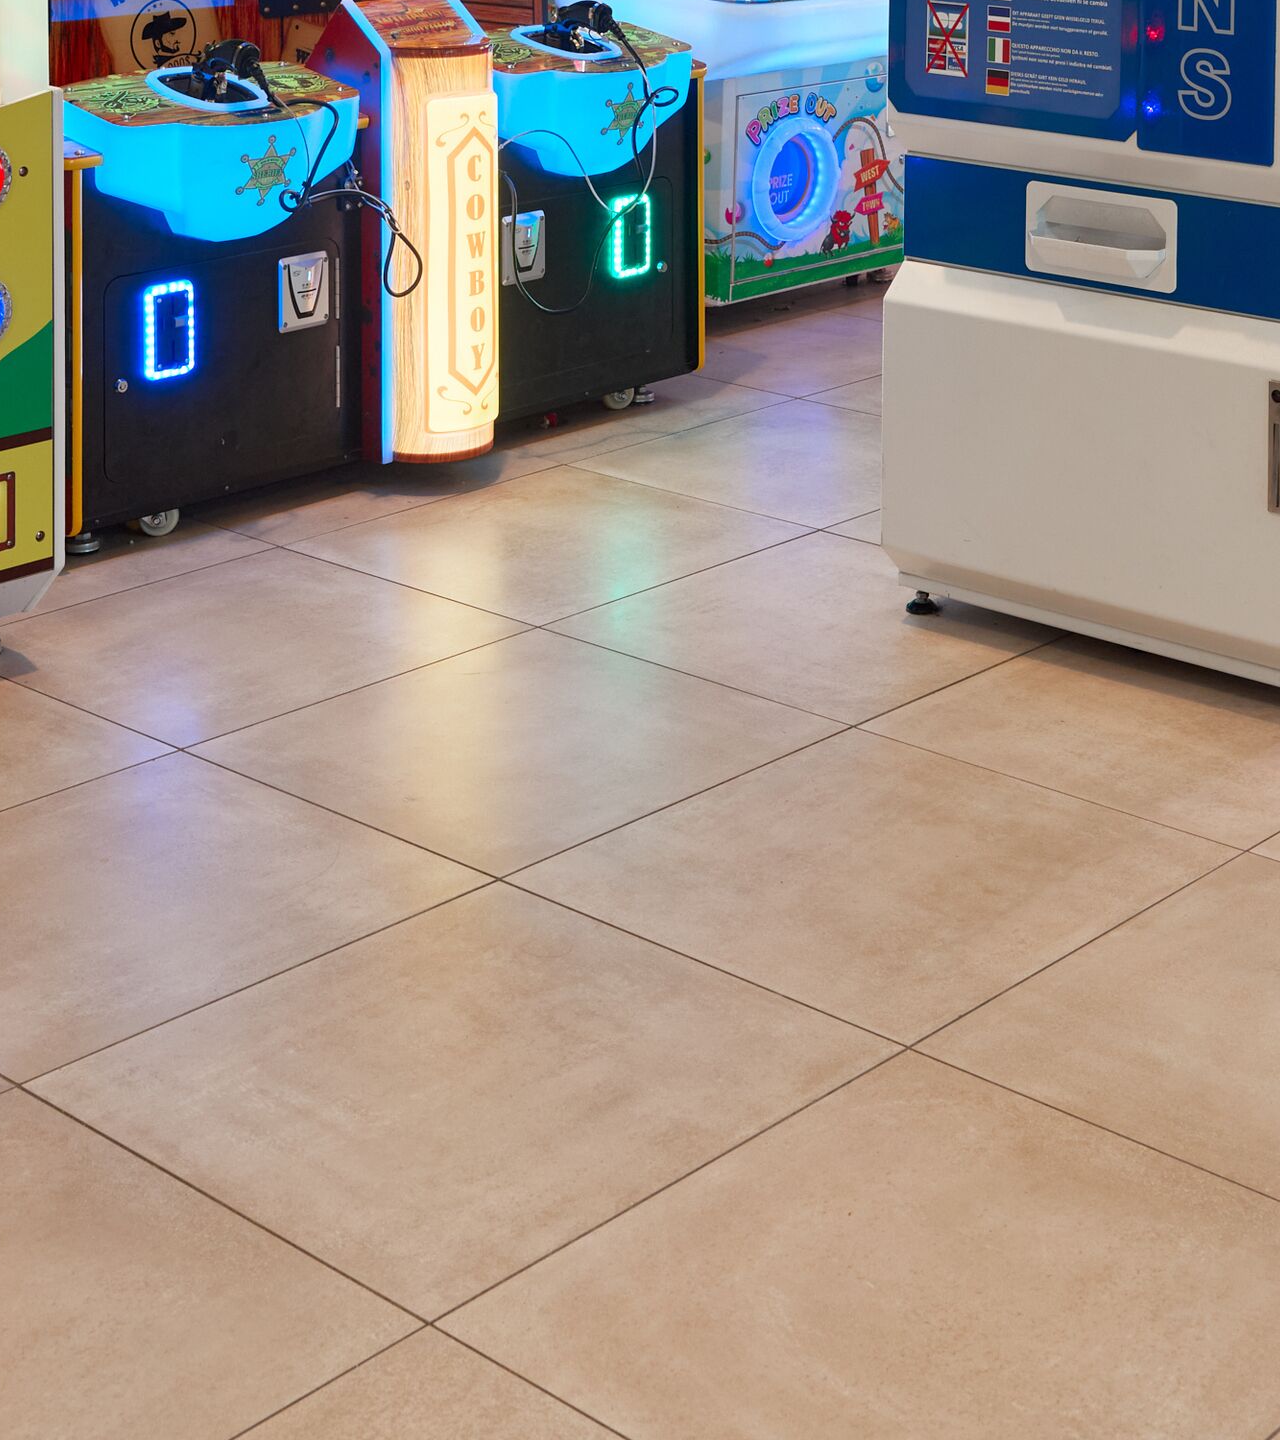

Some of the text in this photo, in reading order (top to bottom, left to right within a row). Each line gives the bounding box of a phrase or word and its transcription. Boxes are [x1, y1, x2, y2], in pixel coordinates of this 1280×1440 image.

[745, 92, 837, 146] PRIZE OUT
[860, 165, 880, 183] WEST
[770, 190, 790, 206] OUT
[465, 153, 487, 371] COWBOY
